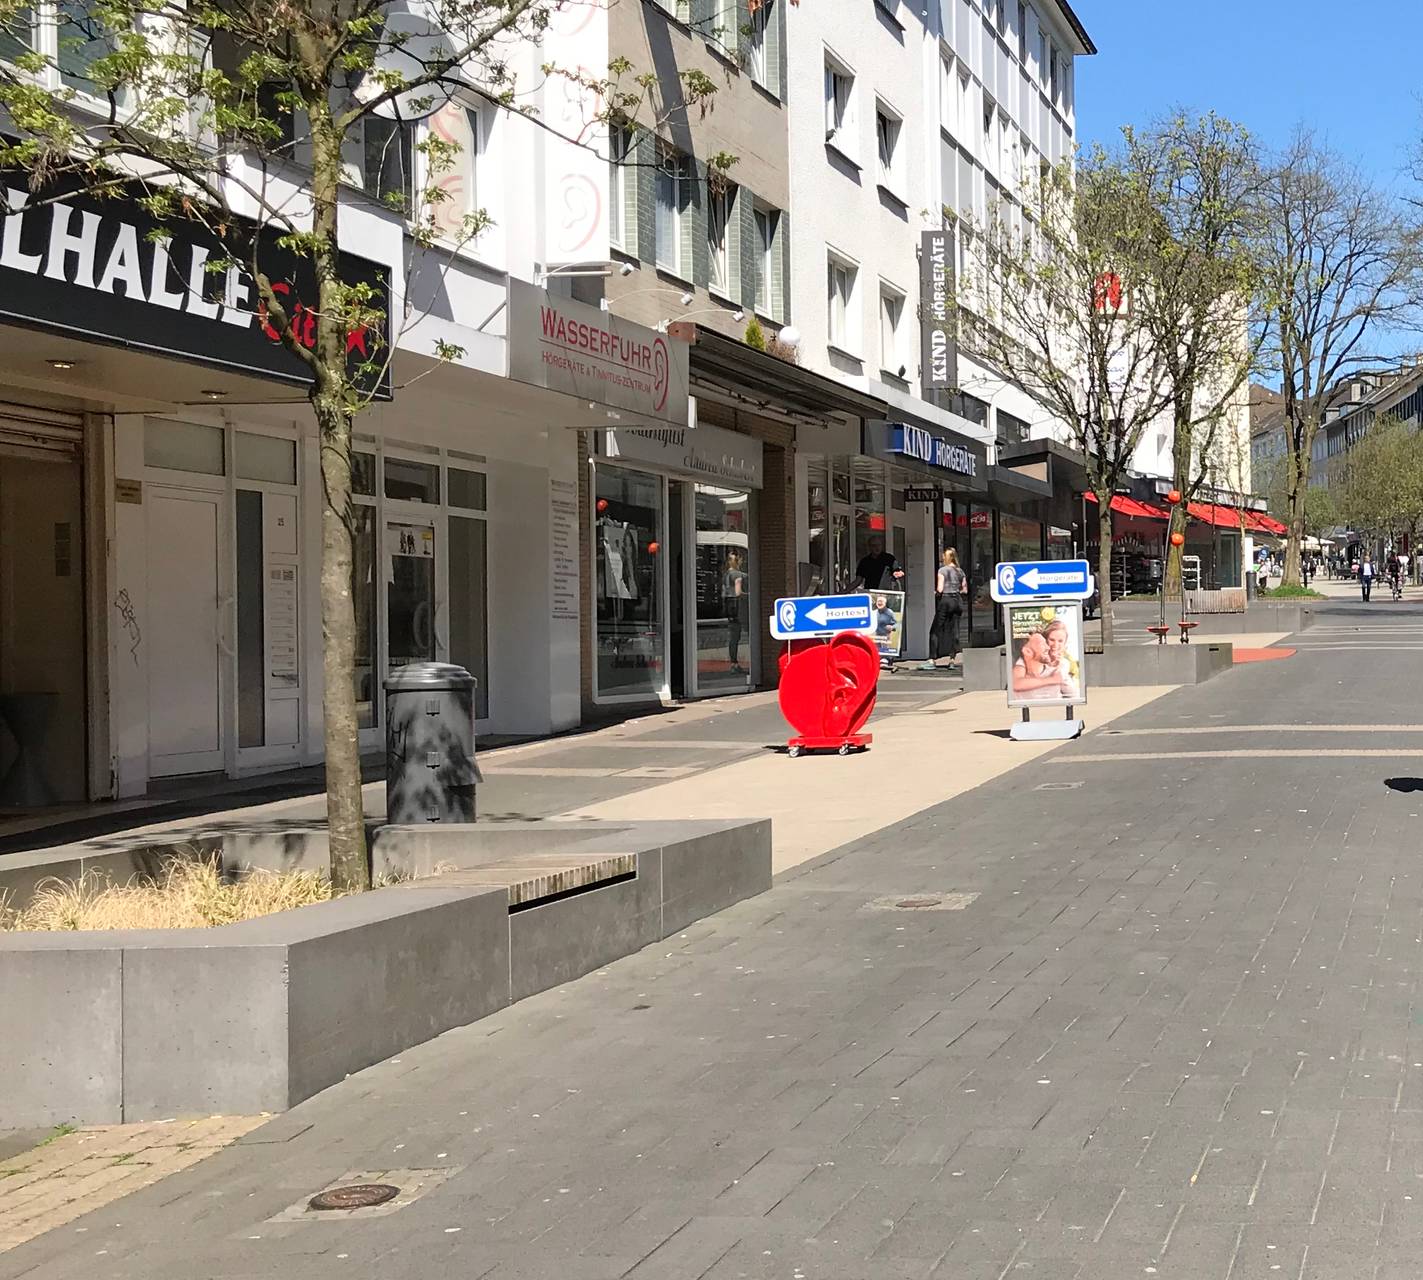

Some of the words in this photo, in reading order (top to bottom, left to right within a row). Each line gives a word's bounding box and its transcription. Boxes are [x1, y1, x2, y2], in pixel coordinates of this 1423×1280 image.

[540, 305, 651, 369] WASSERFUHR
[931, 329, 947, 382] KIND
[903, 422, 932, 461] KIND
[908, 490, 939, 500] KIND
